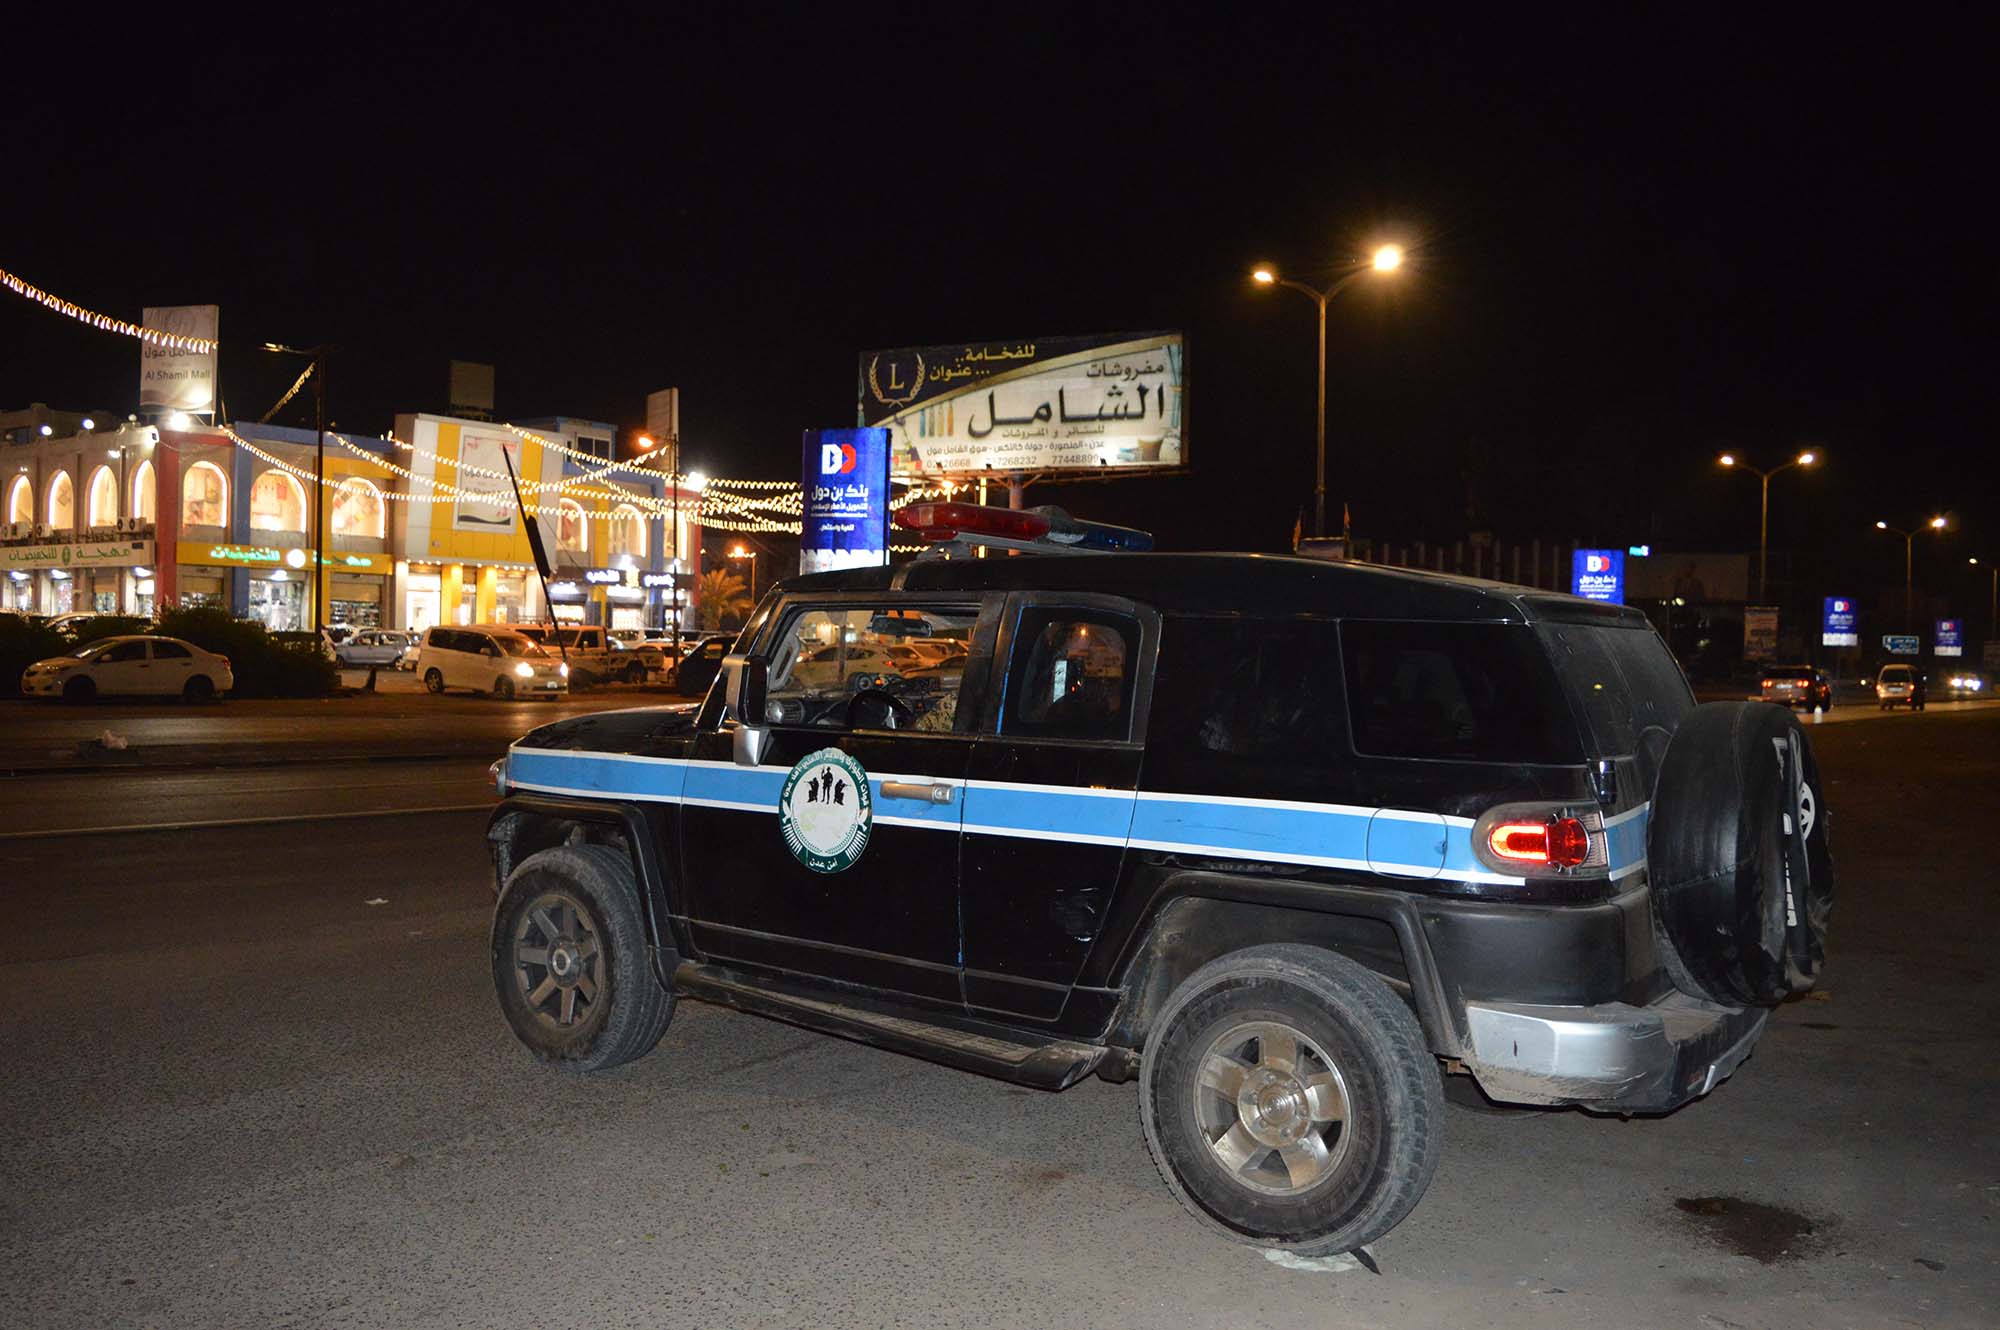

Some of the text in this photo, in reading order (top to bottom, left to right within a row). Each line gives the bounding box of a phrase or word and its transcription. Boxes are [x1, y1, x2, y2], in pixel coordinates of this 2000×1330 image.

[145, 369, 210, 380] Al Shamil Mall
[889, 363, 905, 390] L
[1086, 360, 1165, 381] مفروشات
[967, 382, 1165, 438] الشامل
[811, 484, 869, 503] بنك بن دول
[76, 546, 130, 560] مهجة
[210, 546, 280, 563] للتخفيضات
[809, 857, 825, 868] عدن
